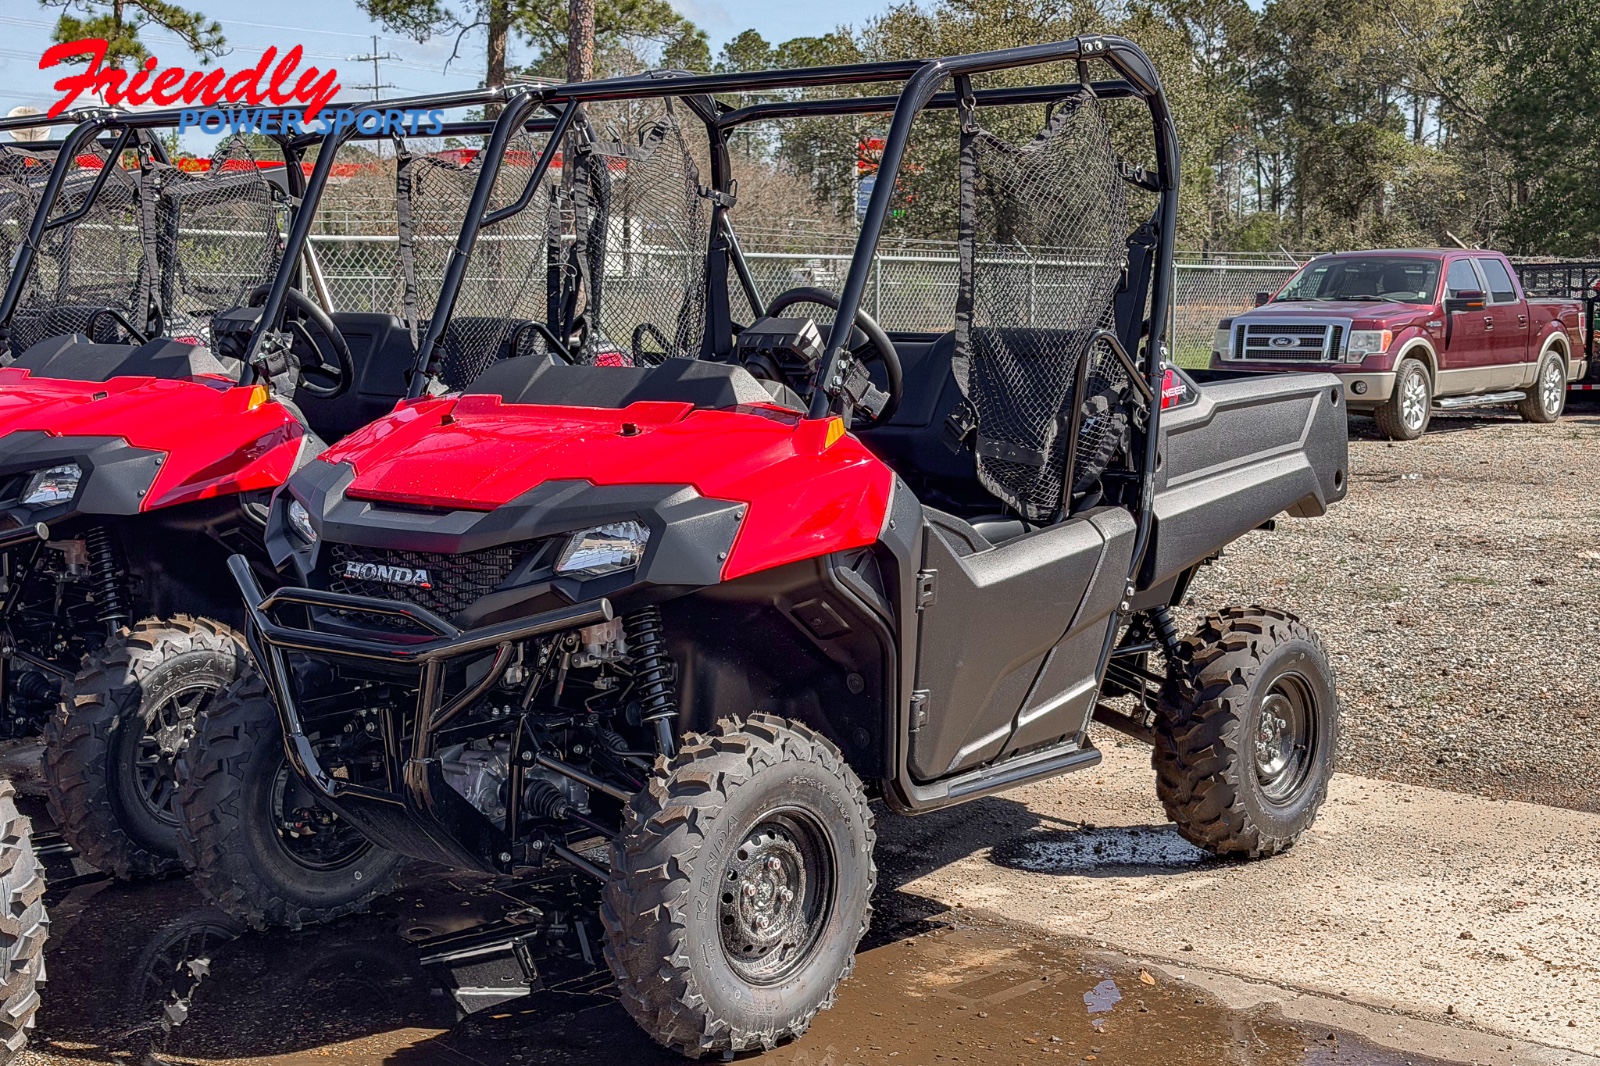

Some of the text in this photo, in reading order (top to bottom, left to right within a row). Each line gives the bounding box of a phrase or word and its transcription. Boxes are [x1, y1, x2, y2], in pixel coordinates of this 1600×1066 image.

[1161, 384, 1187, 398] NEER
[345, 561, 431, 588] HONDA
[696, 815, 739, 922] KENDA
